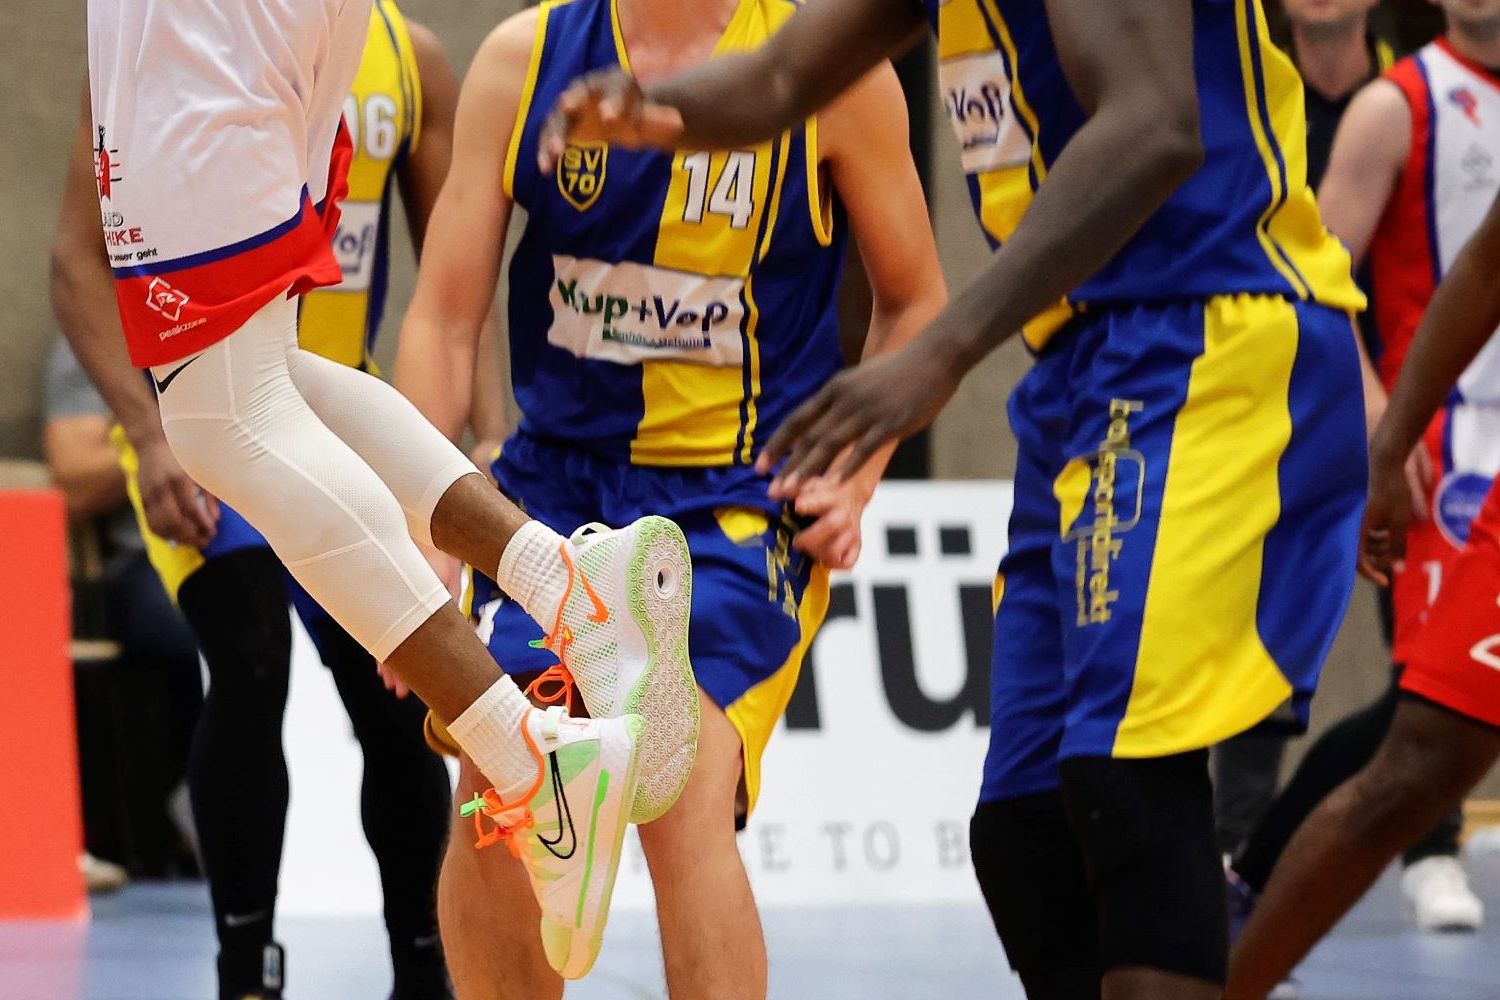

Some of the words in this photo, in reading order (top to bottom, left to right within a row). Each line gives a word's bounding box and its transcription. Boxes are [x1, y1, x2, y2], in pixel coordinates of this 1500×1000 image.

[565, 147, 600, 171] SV
[682, 150, 756, 229] 14
[819, 820, 902, 874] TO
